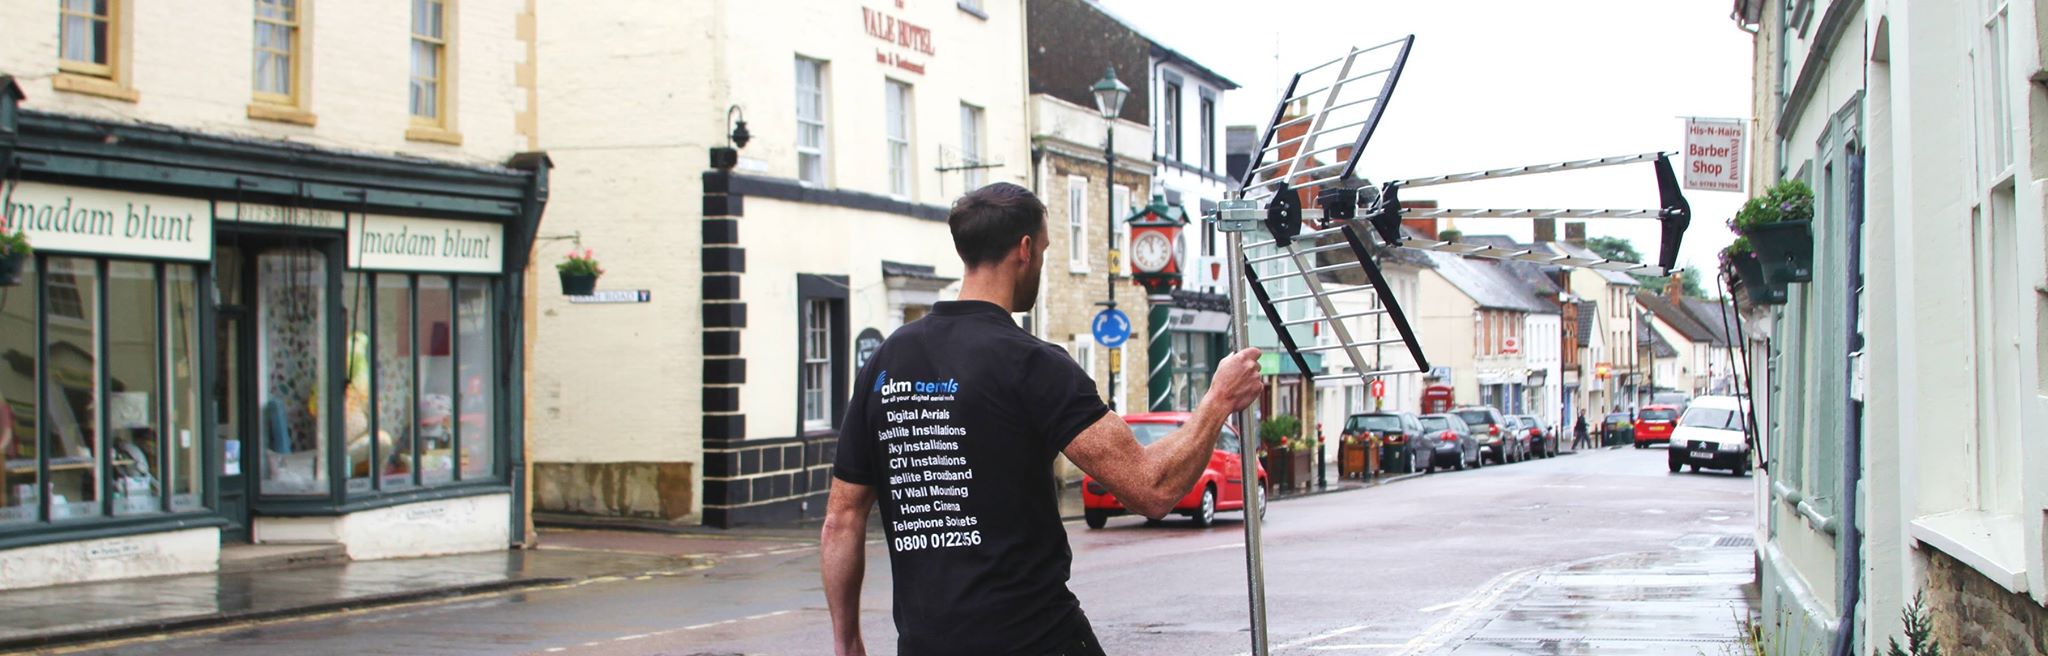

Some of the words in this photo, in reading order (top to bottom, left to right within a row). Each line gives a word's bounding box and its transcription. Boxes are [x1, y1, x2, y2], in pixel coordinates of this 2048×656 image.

[862, 6, 895, 43] VALE
[897, 19, 935, 56] HOTEL
[1690, 126, 1742, 137] His-N-Hairs
[1690, 143, 1730, 158] Barber
[1692, 160, 1723, 177] Shop
[8, 196, 114, 236] madam
[125, 202, 193, 242] blunt
[363, 224, 436, 256] madam
[442, 227, 491, 259] blunt
[881, 378, 912, 396] akm
[911, 394, 930, 402] digital
[887, 409, 918, 423] Digital
[891, 489, 902, 500] TV
[904, 486, 928, 498] Wall
[900, 503, 931, 515] Home
[893, 518, 944, 532] Telephone
[895, 534, 928, 552] 0800
